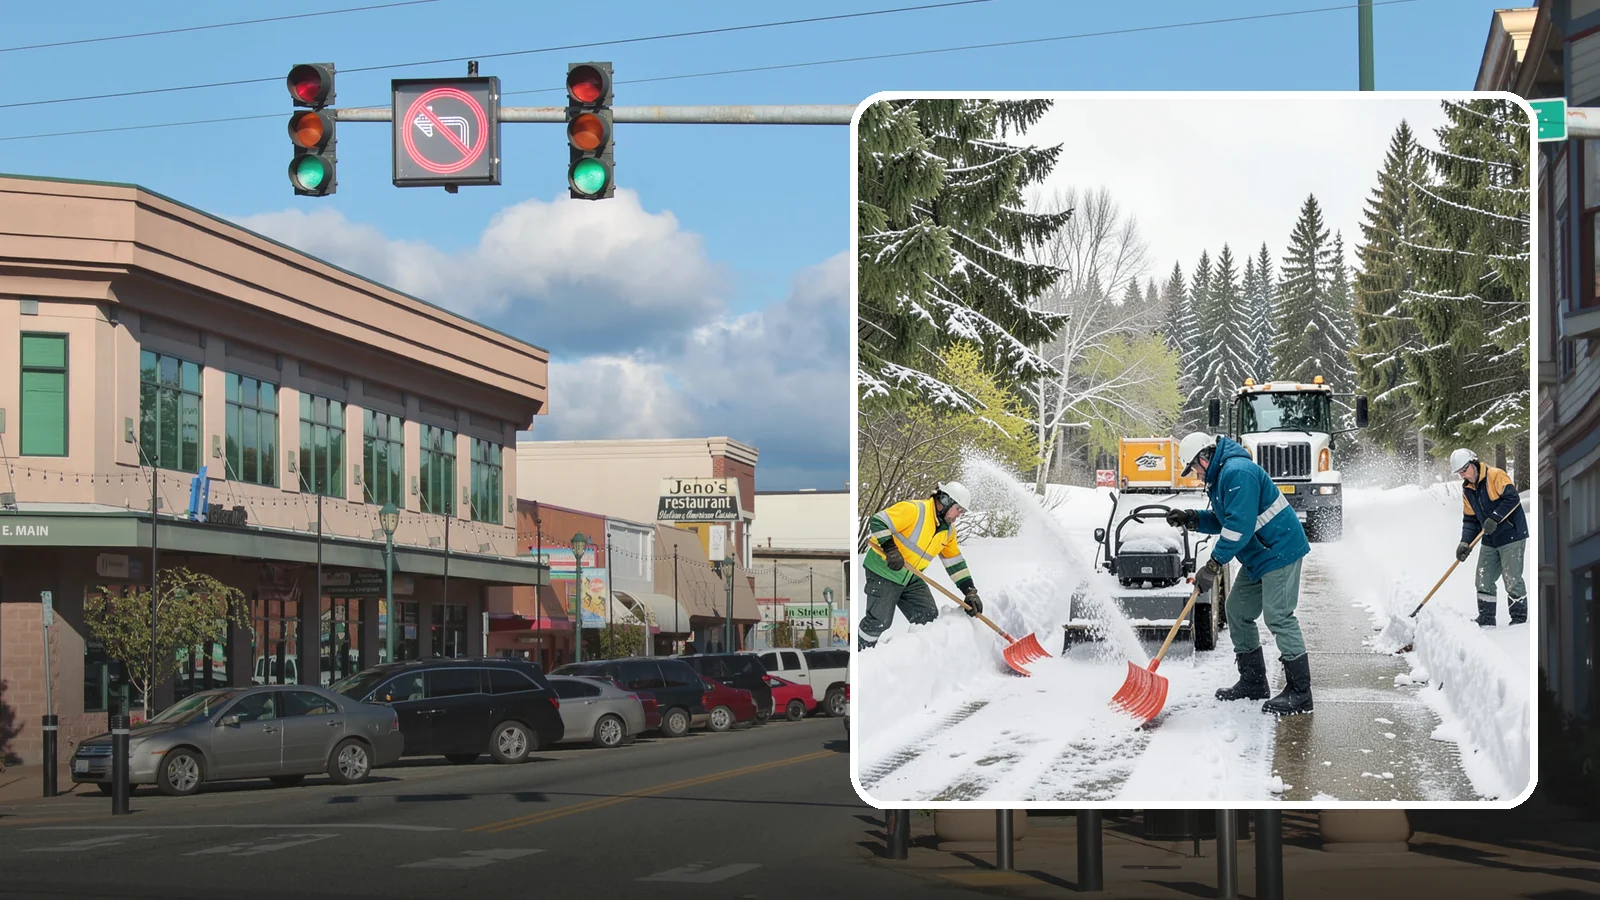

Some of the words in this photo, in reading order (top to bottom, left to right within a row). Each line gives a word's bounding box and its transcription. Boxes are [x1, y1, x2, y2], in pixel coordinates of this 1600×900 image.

[670, 480, 727, 494] Jeno's
[665, 496, 731, 509] restaurant
[659, 510, 681, 519] Italian
[686, 510, 714, 519] American
[715, 510, 737, 519] Cuisine
[2, 525, 13, 536] E.
[15, 525, 49, 536] MAIN
[797, 607, 829, 617] Street
